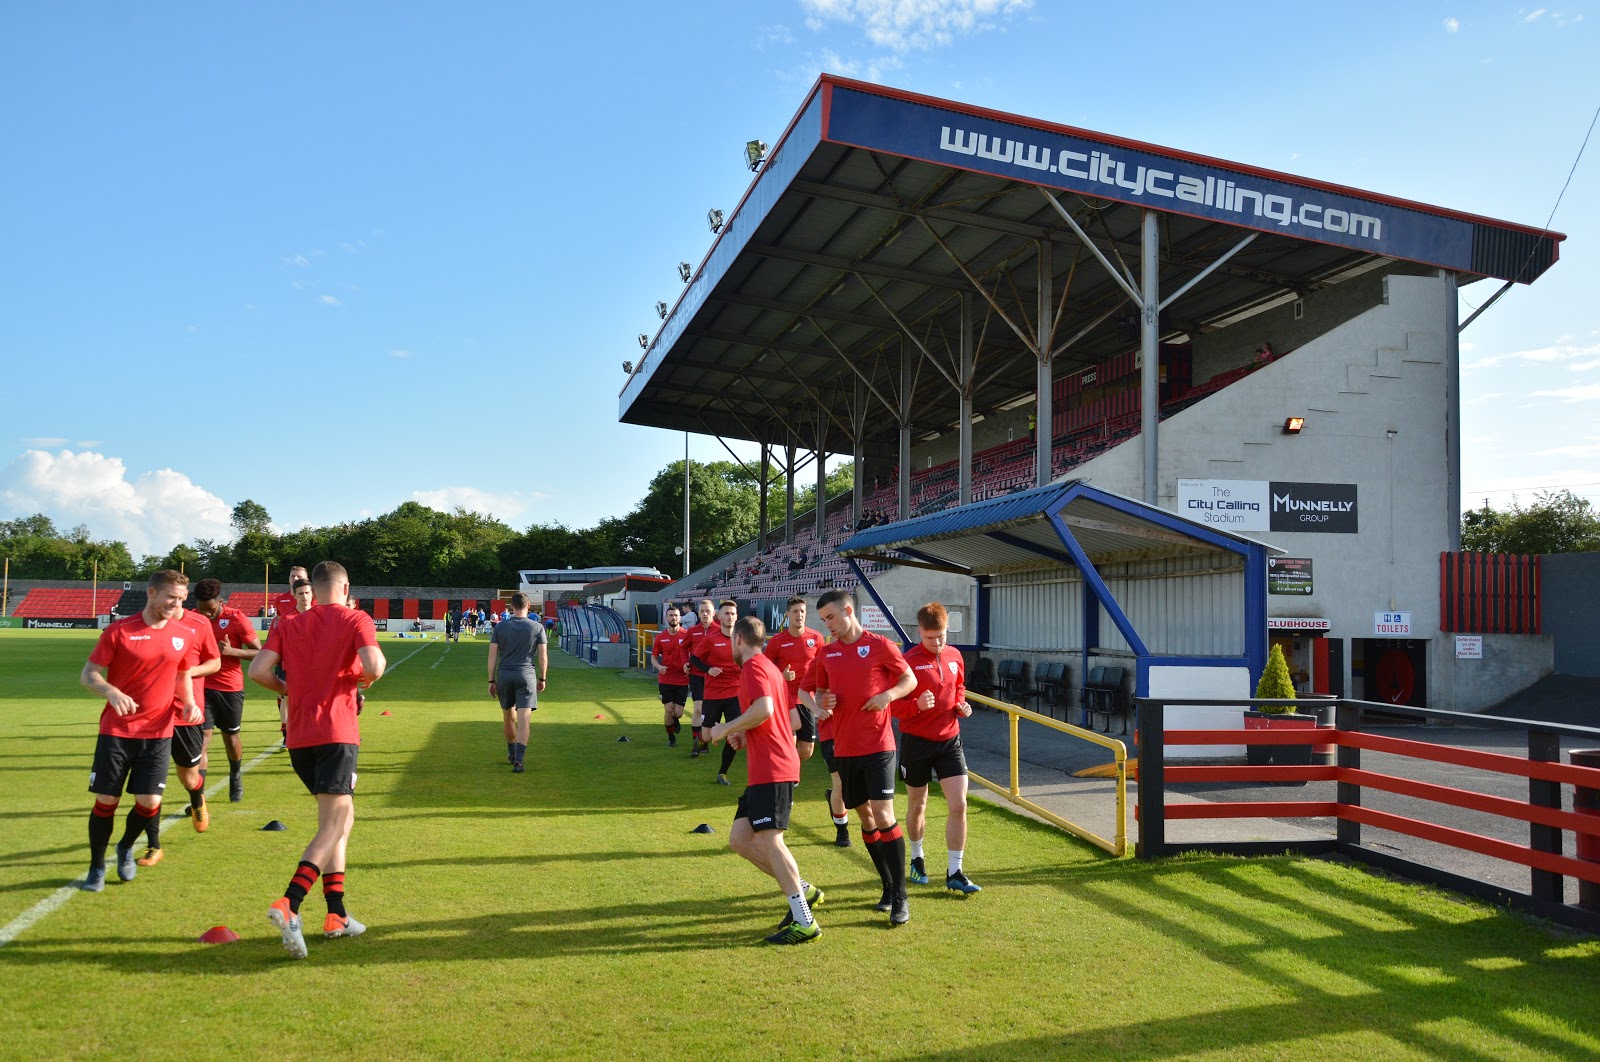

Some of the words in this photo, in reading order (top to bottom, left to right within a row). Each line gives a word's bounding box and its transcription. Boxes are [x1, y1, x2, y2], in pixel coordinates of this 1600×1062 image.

[939, 126, 1381, 240] www.citycalling.com
[1082, 372, 1096, 385] PRESS
[1212, 486, 1230, 497] The
[1188, 500, 1214, 510] City
[1217, 500, 1260, 512] Calling
[1274, 492, 1353, 512] MUNNELLY
[1204, 512, 1244, 523] Stadium
[1300, 514, 1328, 522] GROUP
[28, 620, 73, 628] MUNNELLY
